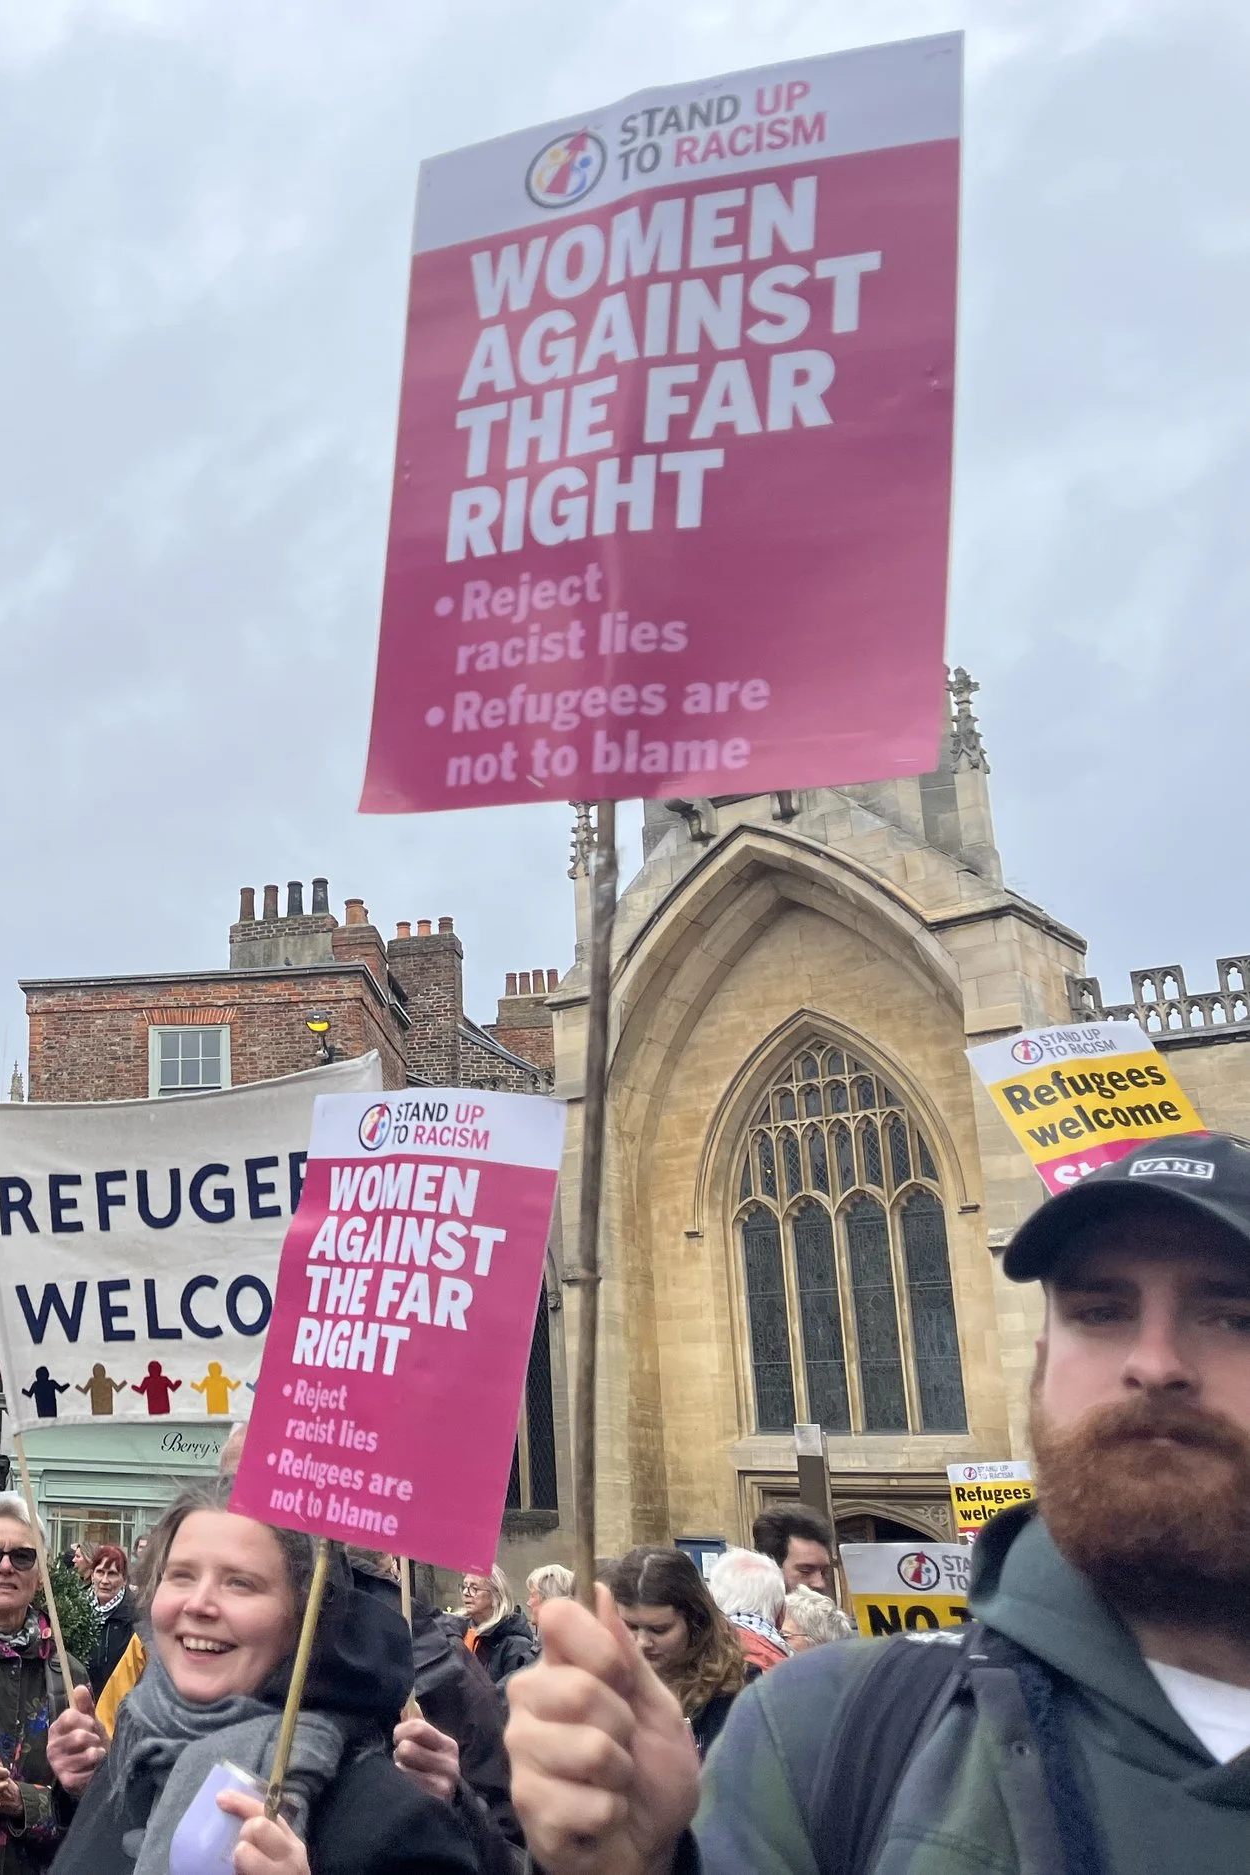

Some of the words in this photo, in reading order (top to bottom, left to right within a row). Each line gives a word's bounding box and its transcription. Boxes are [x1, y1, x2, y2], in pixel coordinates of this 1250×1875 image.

[618, 95, 741, 146] STAND
[755, 80, 811, 118] UP
[617, 142, 662, 182] TO
[674, 111, 829, 167] RACISM
[471, 175, 818, 320] WOMEN
[458, 251, 882, 400] AGAINST
[455, 375, 619, 478] THE
[643, 349, 836, 443] FAR
[445, 448, 724, 563] RIGHT
[461, 562, 603, 623] Reject
[455, 619, 585, 675] racist
[598, 612, 688, 655] lies
[451, 681, 667, 733] Refugees
[682, 677, 770, 714] are
[445, 747, 517, 789] not
[531, 742, 578, 778] to
[592, 730, 750, 774] blame
[1039, 1031, 1082, 1048] STAND
[1083, 1028, 1101, 1043] UP
[1047, 1044, 1067, 1059] TO
[1071, 1039, 1118, 1056] RACISM
[395, 1102, 448, 1123] STAND
[455, 1104, 485, 1124] UP
[1002, 1064, 1167, 1116] Refugees
[392, 1125, 408, 1145] TO
[414, 1127, 489, 1150] RACISM
[1026, 1100, 1182, 1148] welcome
[328, 1163, 480, 1218] WOMEN
[1139, 1160, 1207, 1176] VANS
[308, 1215, 507, 1277] AGAINST
[15, 1274, 273, 1344] WELCO
[306, 1265, 373, 1316] THE
[375, 1269, 474, 1331] FAR
[292, 1317, 410, 1376] RIGHT
[293, 1379, 348, 1413] Reject
[161, 1432, 220, 1459] Berry's
[285, 1416, 335, 1446] racist
[339, 1419, 379, 1453] lies
[278, 1448, 364, 1490] Refugees
[369, 1474, 413, 1501] are
[955, 1486, 1031, 1504] Refugees
[269, 1488, 303, 1514] not
[307, 1492, 322, 1518] to
[326, 1494, 399, 1536] blame
[866, 1605, 940, 1637] NO
